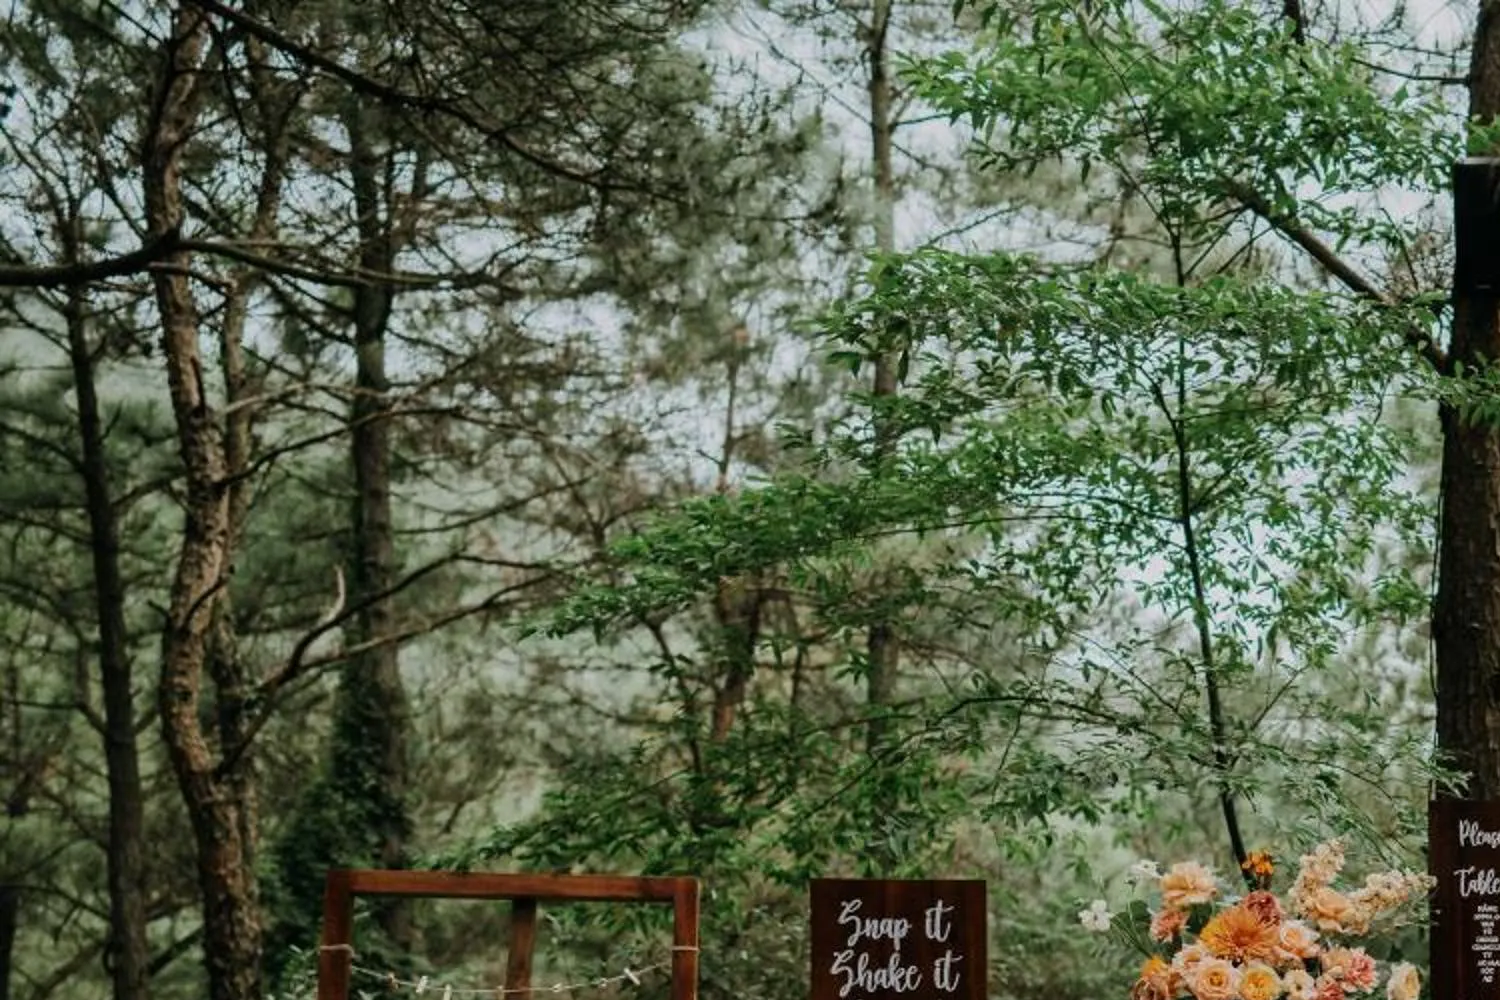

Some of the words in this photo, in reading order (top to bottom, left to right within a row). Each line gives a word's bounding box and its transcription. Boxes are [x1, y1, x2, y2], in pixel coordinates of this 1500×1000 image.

[838, 899, 912, 950] Snap
[924, 900, 954, 942] it
[830, 949, 922, 997] Shake
[933, 950, 963, 992] it
